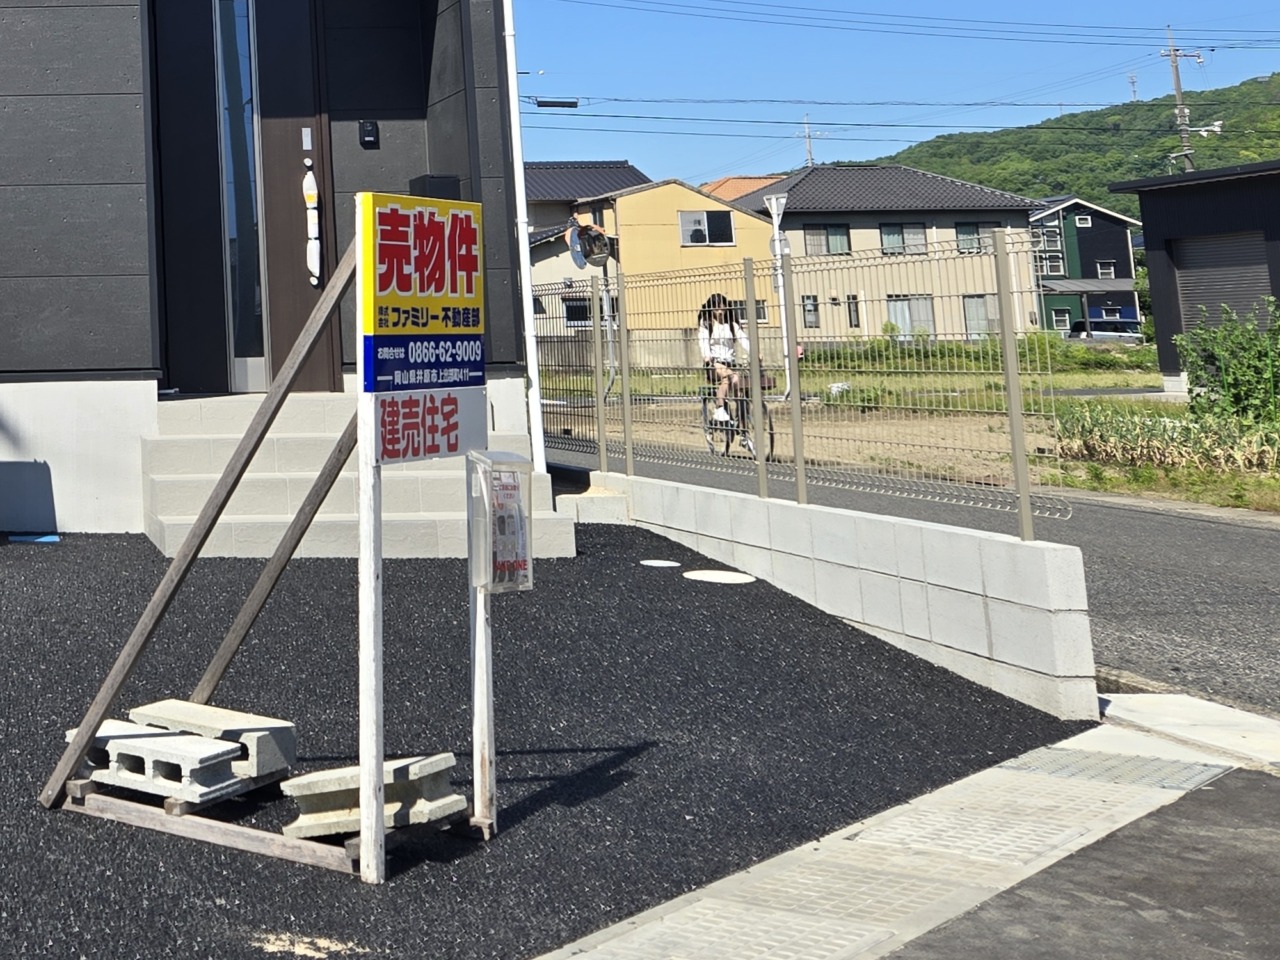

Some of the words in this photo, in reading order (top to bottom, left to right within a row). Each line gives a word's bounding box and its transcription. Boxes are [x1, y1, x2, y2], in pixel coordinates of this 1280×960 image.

[376, 205, 480, 296] 売物件
[377, 346, 405, 359] お問合せは
[408, 340, 482, 363] 0866-62-9009
[380, 392, 459, 461] 建売住宅
[513, 559, 528, 571] ONE
